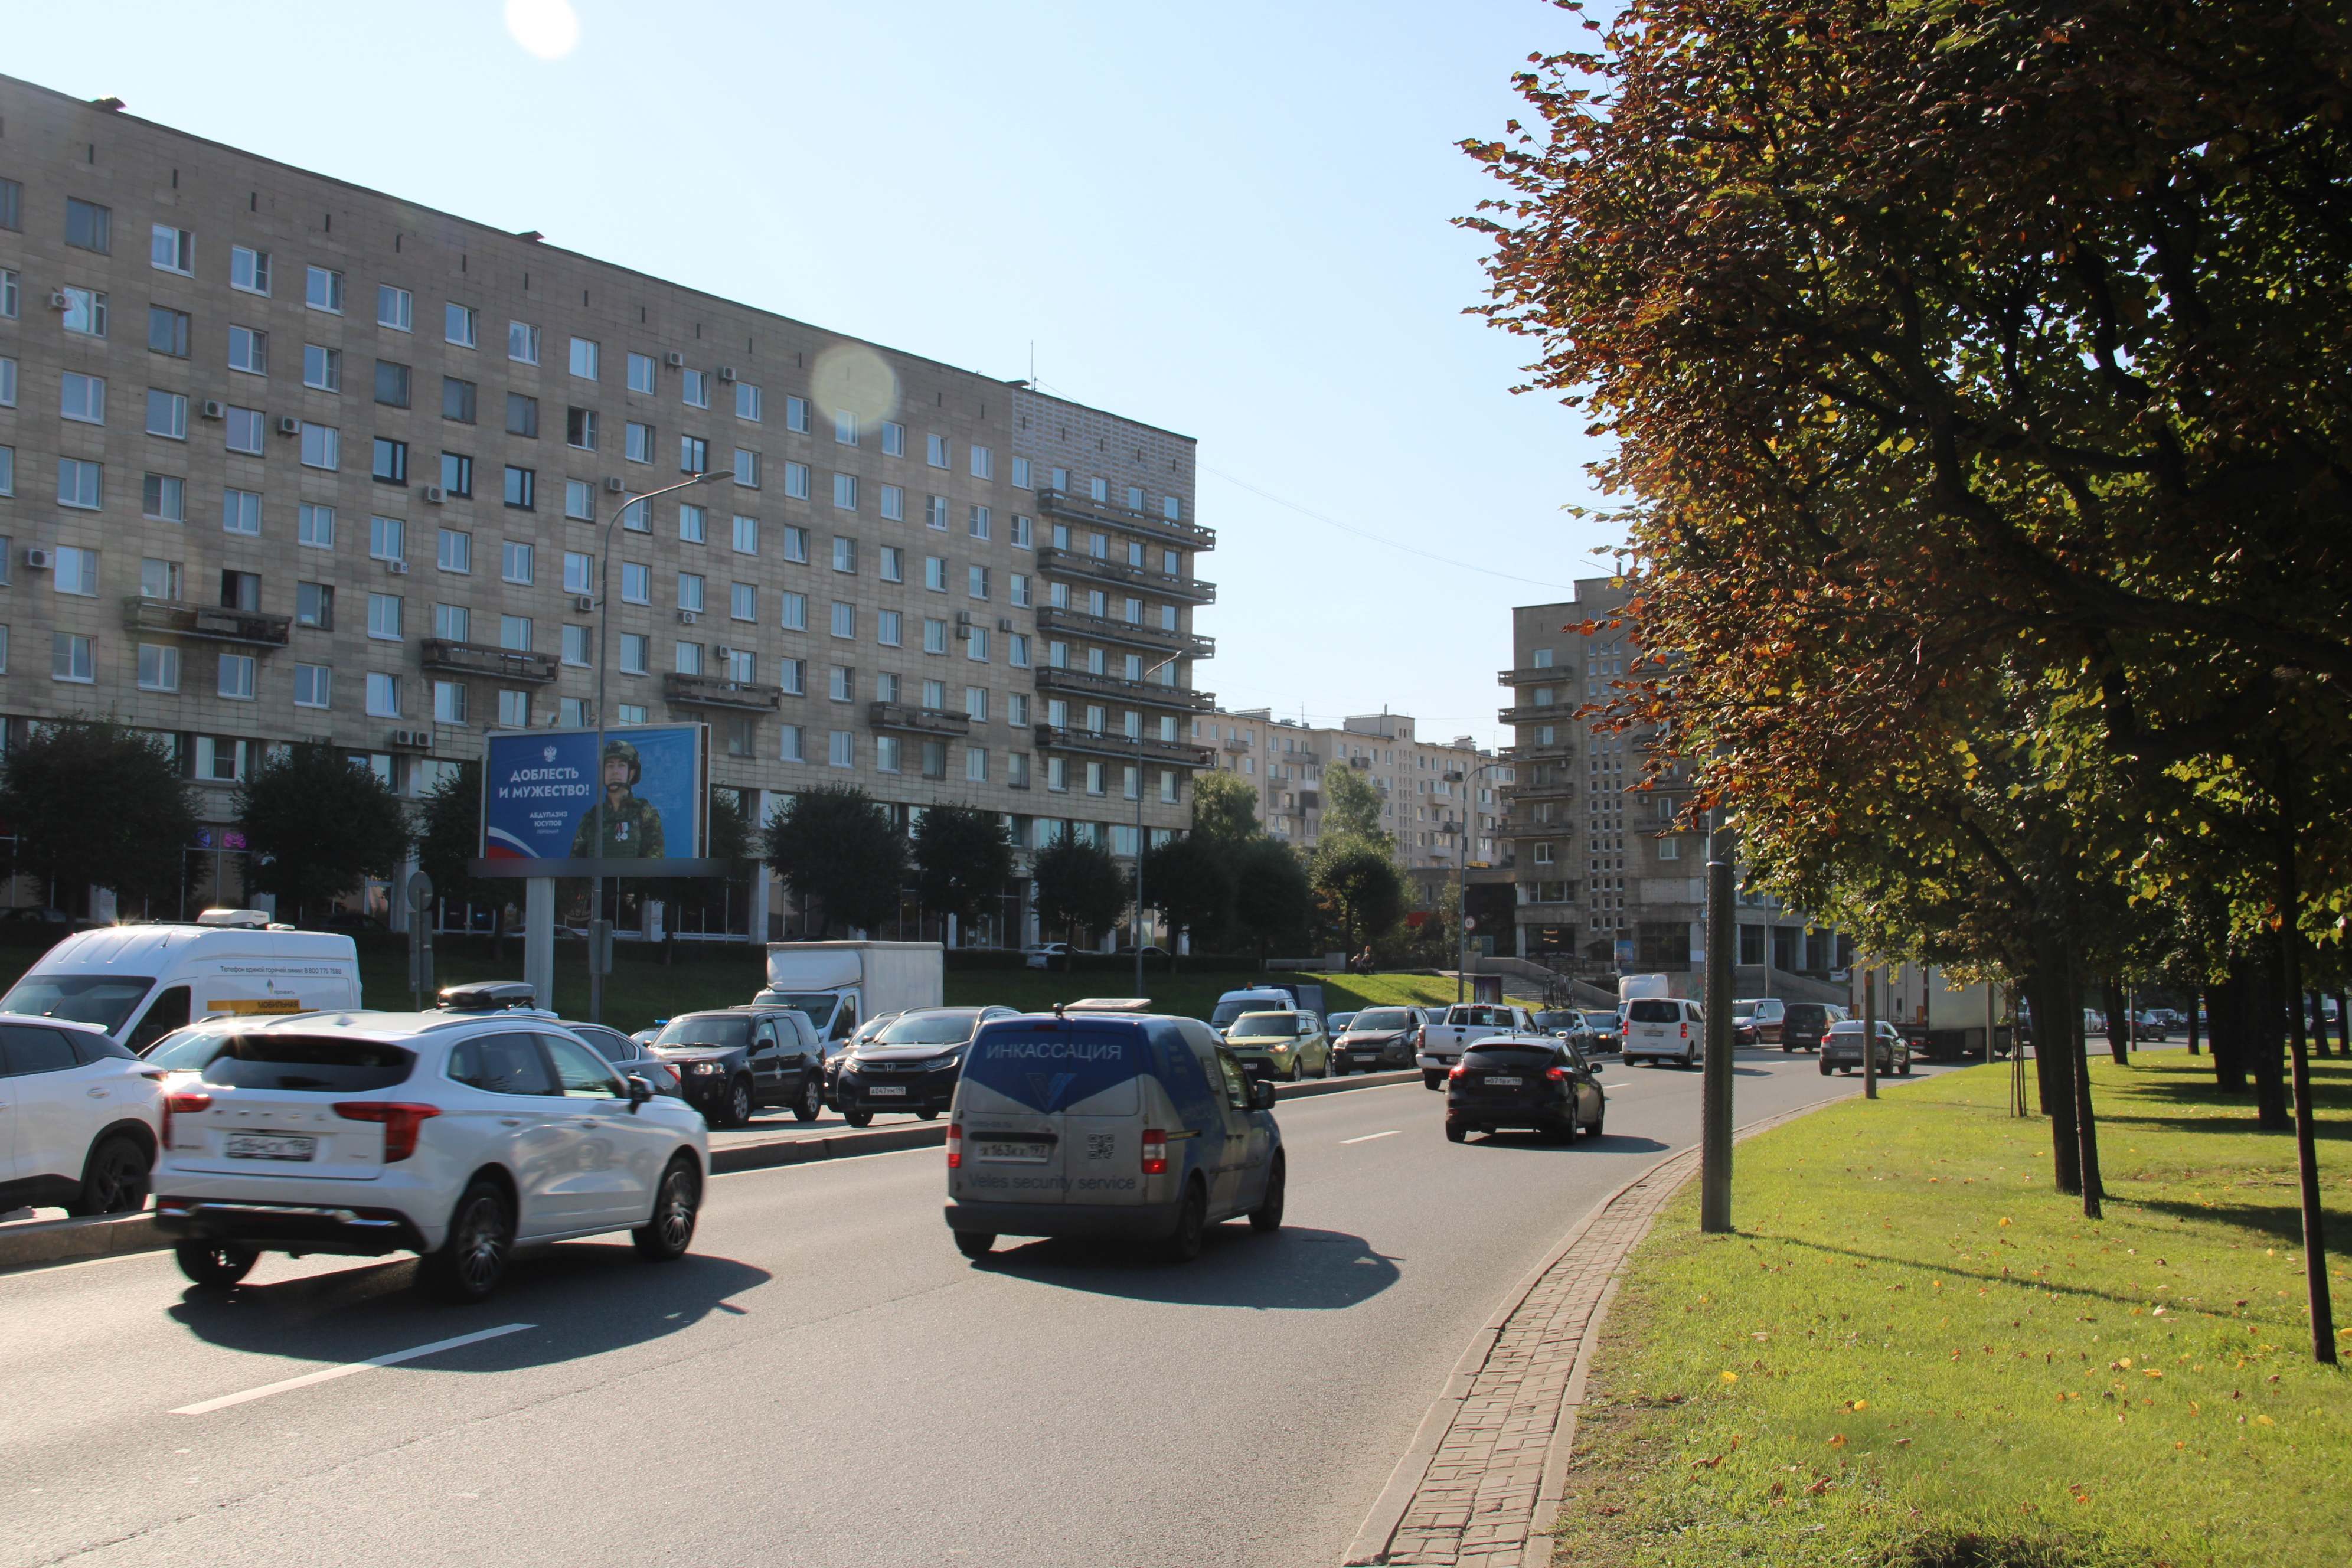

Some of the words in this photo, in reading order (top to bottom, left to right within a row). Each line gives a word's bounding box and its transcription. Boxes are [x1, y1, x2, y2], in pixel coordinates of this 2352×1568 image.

[510, 767, 579, 783] ДОБЛЕСТЬ
[499, 787, 508, 798] И
[512, 784, 589, 798] МУЖЕСТВО!
[986, 1043, 1122, 1062] ИНКАССАЦИЯ
[969, 1174, 1009, 1189] Veles
[1012, 1174, 1072, 1192] security
[1078, 1175, 1136, 1190] service
